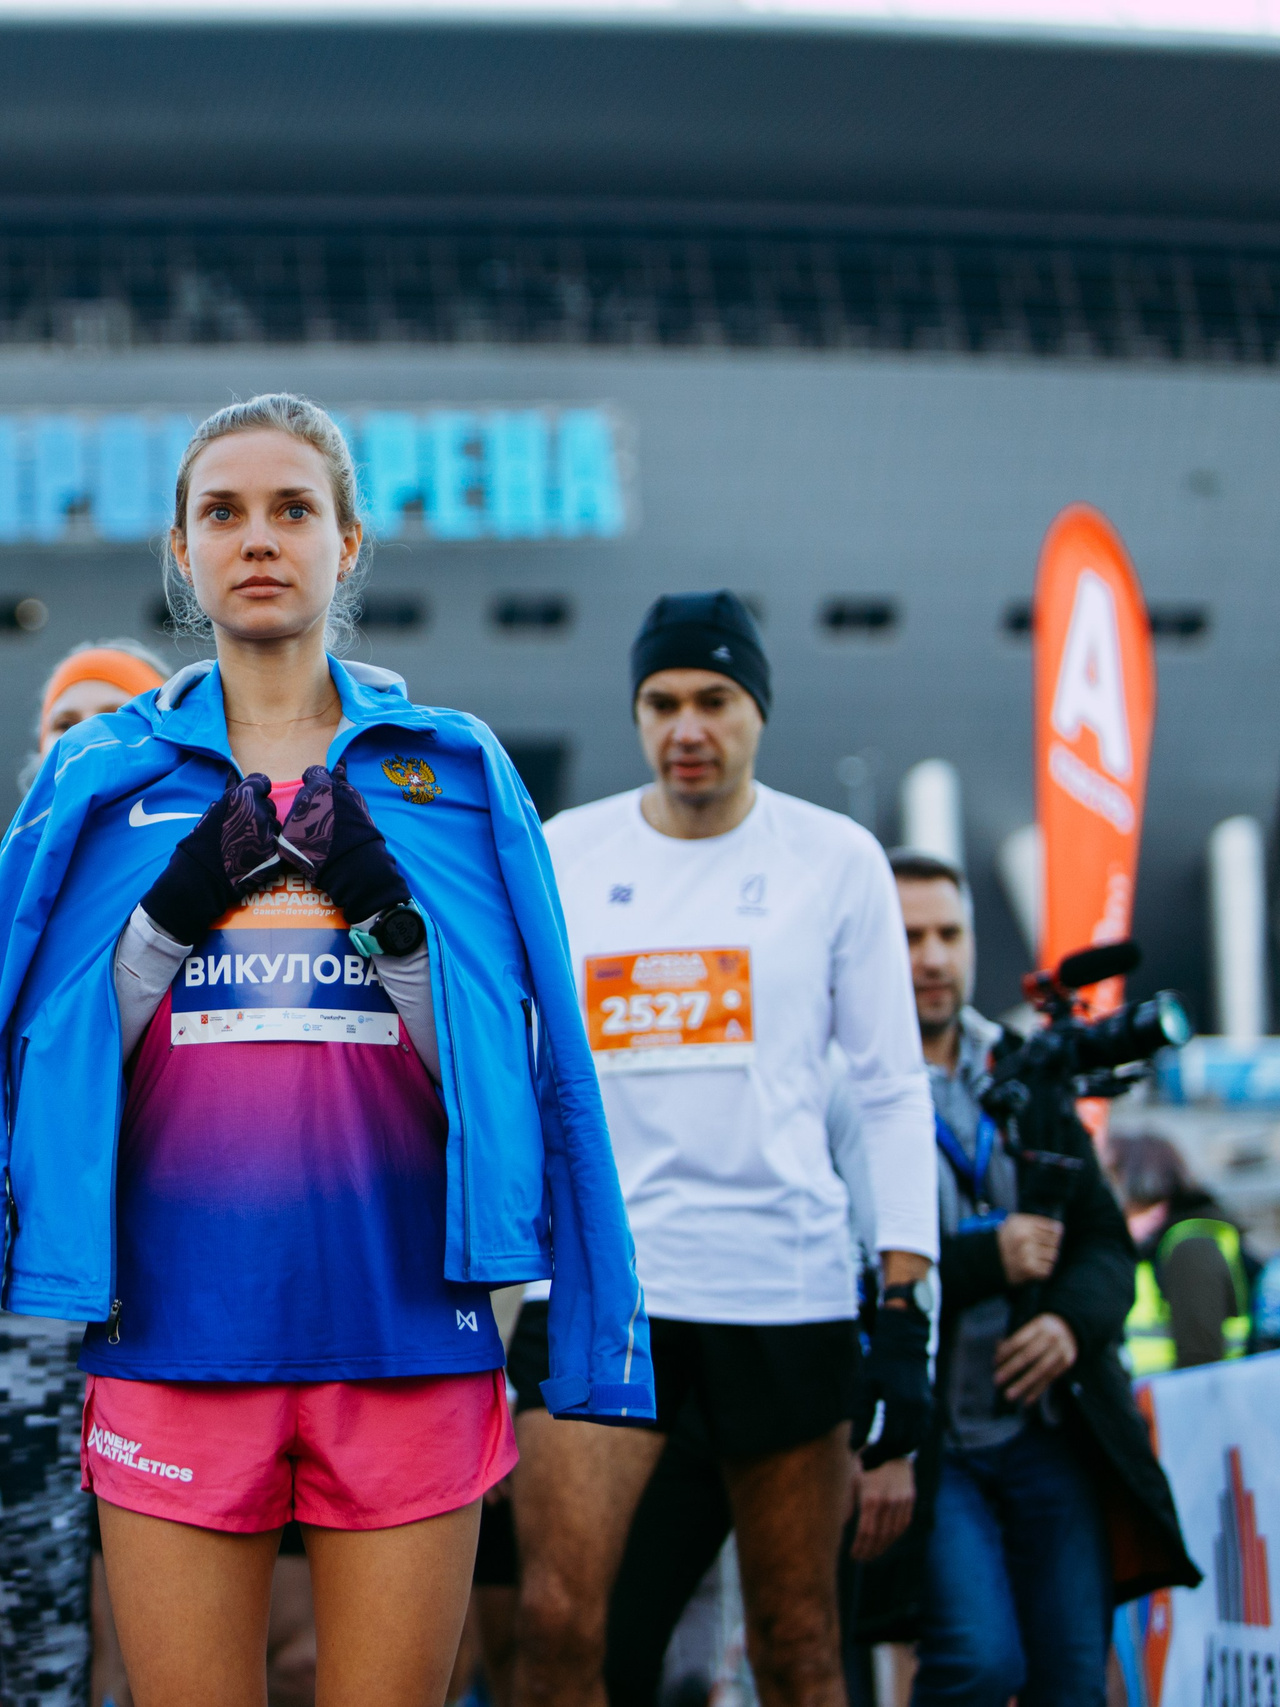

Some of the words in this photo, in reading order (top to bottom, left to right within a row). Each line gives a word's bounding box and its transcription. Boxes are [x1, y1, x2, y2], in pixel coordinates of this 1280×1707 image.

[241, 892, 334, 906] МАРАФО
[252, 907, 336, 916] Санкт-Петербург
[600, 991, 710, 1035] 2527
[103, 1430, 142, 1454] NEW
[102, 1446, 193, 1482] ATHLETICS
